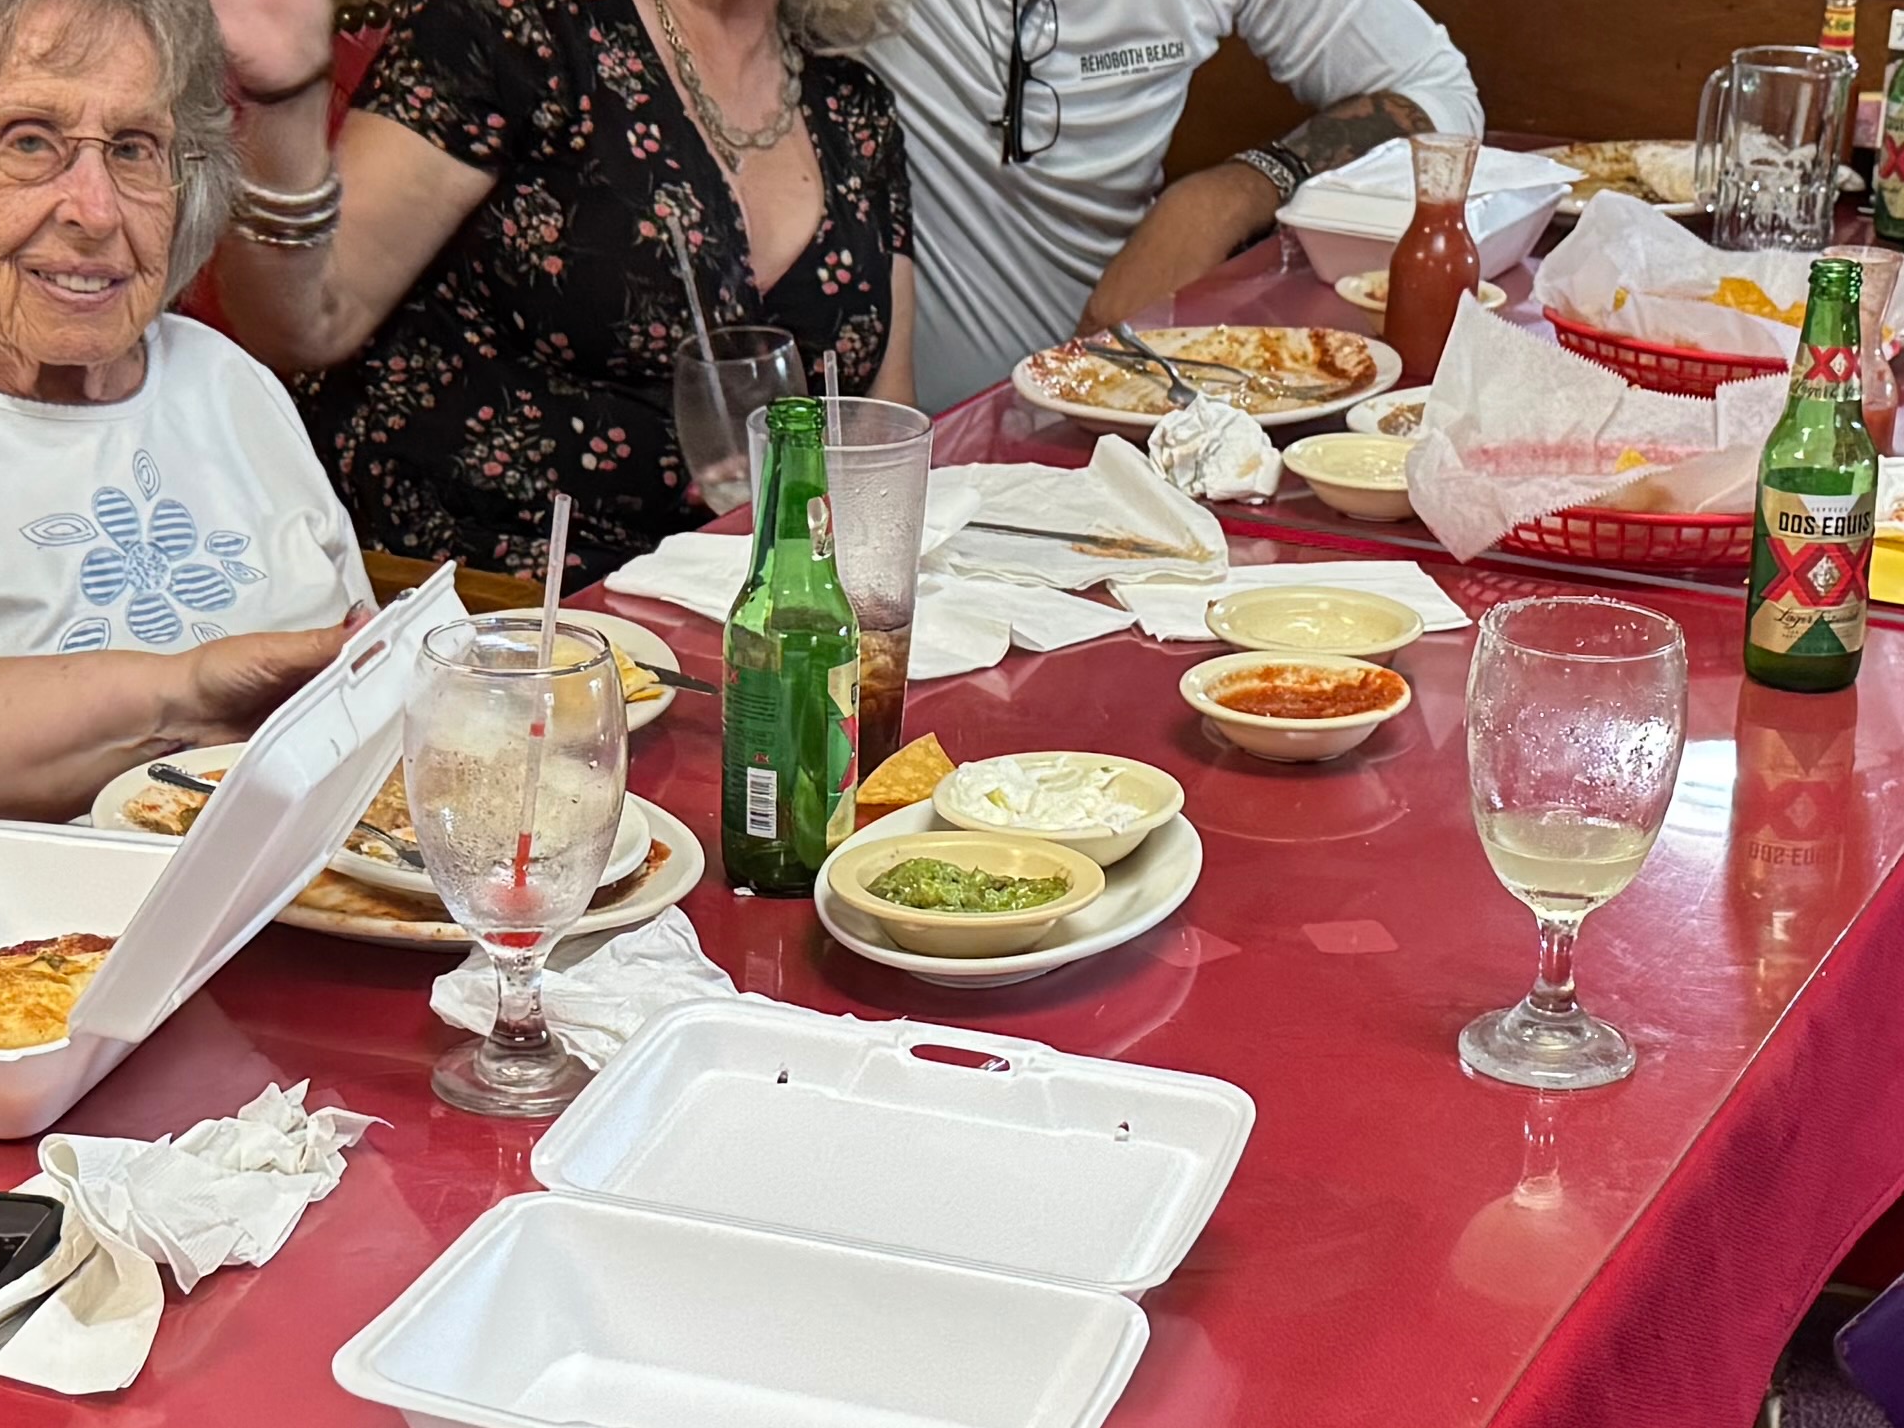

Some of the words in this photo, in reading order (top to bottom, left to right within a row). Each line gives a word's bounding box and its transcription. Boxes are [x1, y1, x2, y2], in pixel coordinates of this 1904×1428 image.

[1080, 49, 1144, 74] REHOBOTH
[1145, 41, 1185, 63] BEACH
[1778, 511, 1816, 535] DOS
[1822, 511, 1871, 537] EQUIS
[1759, 536, 1873, 608] XX
